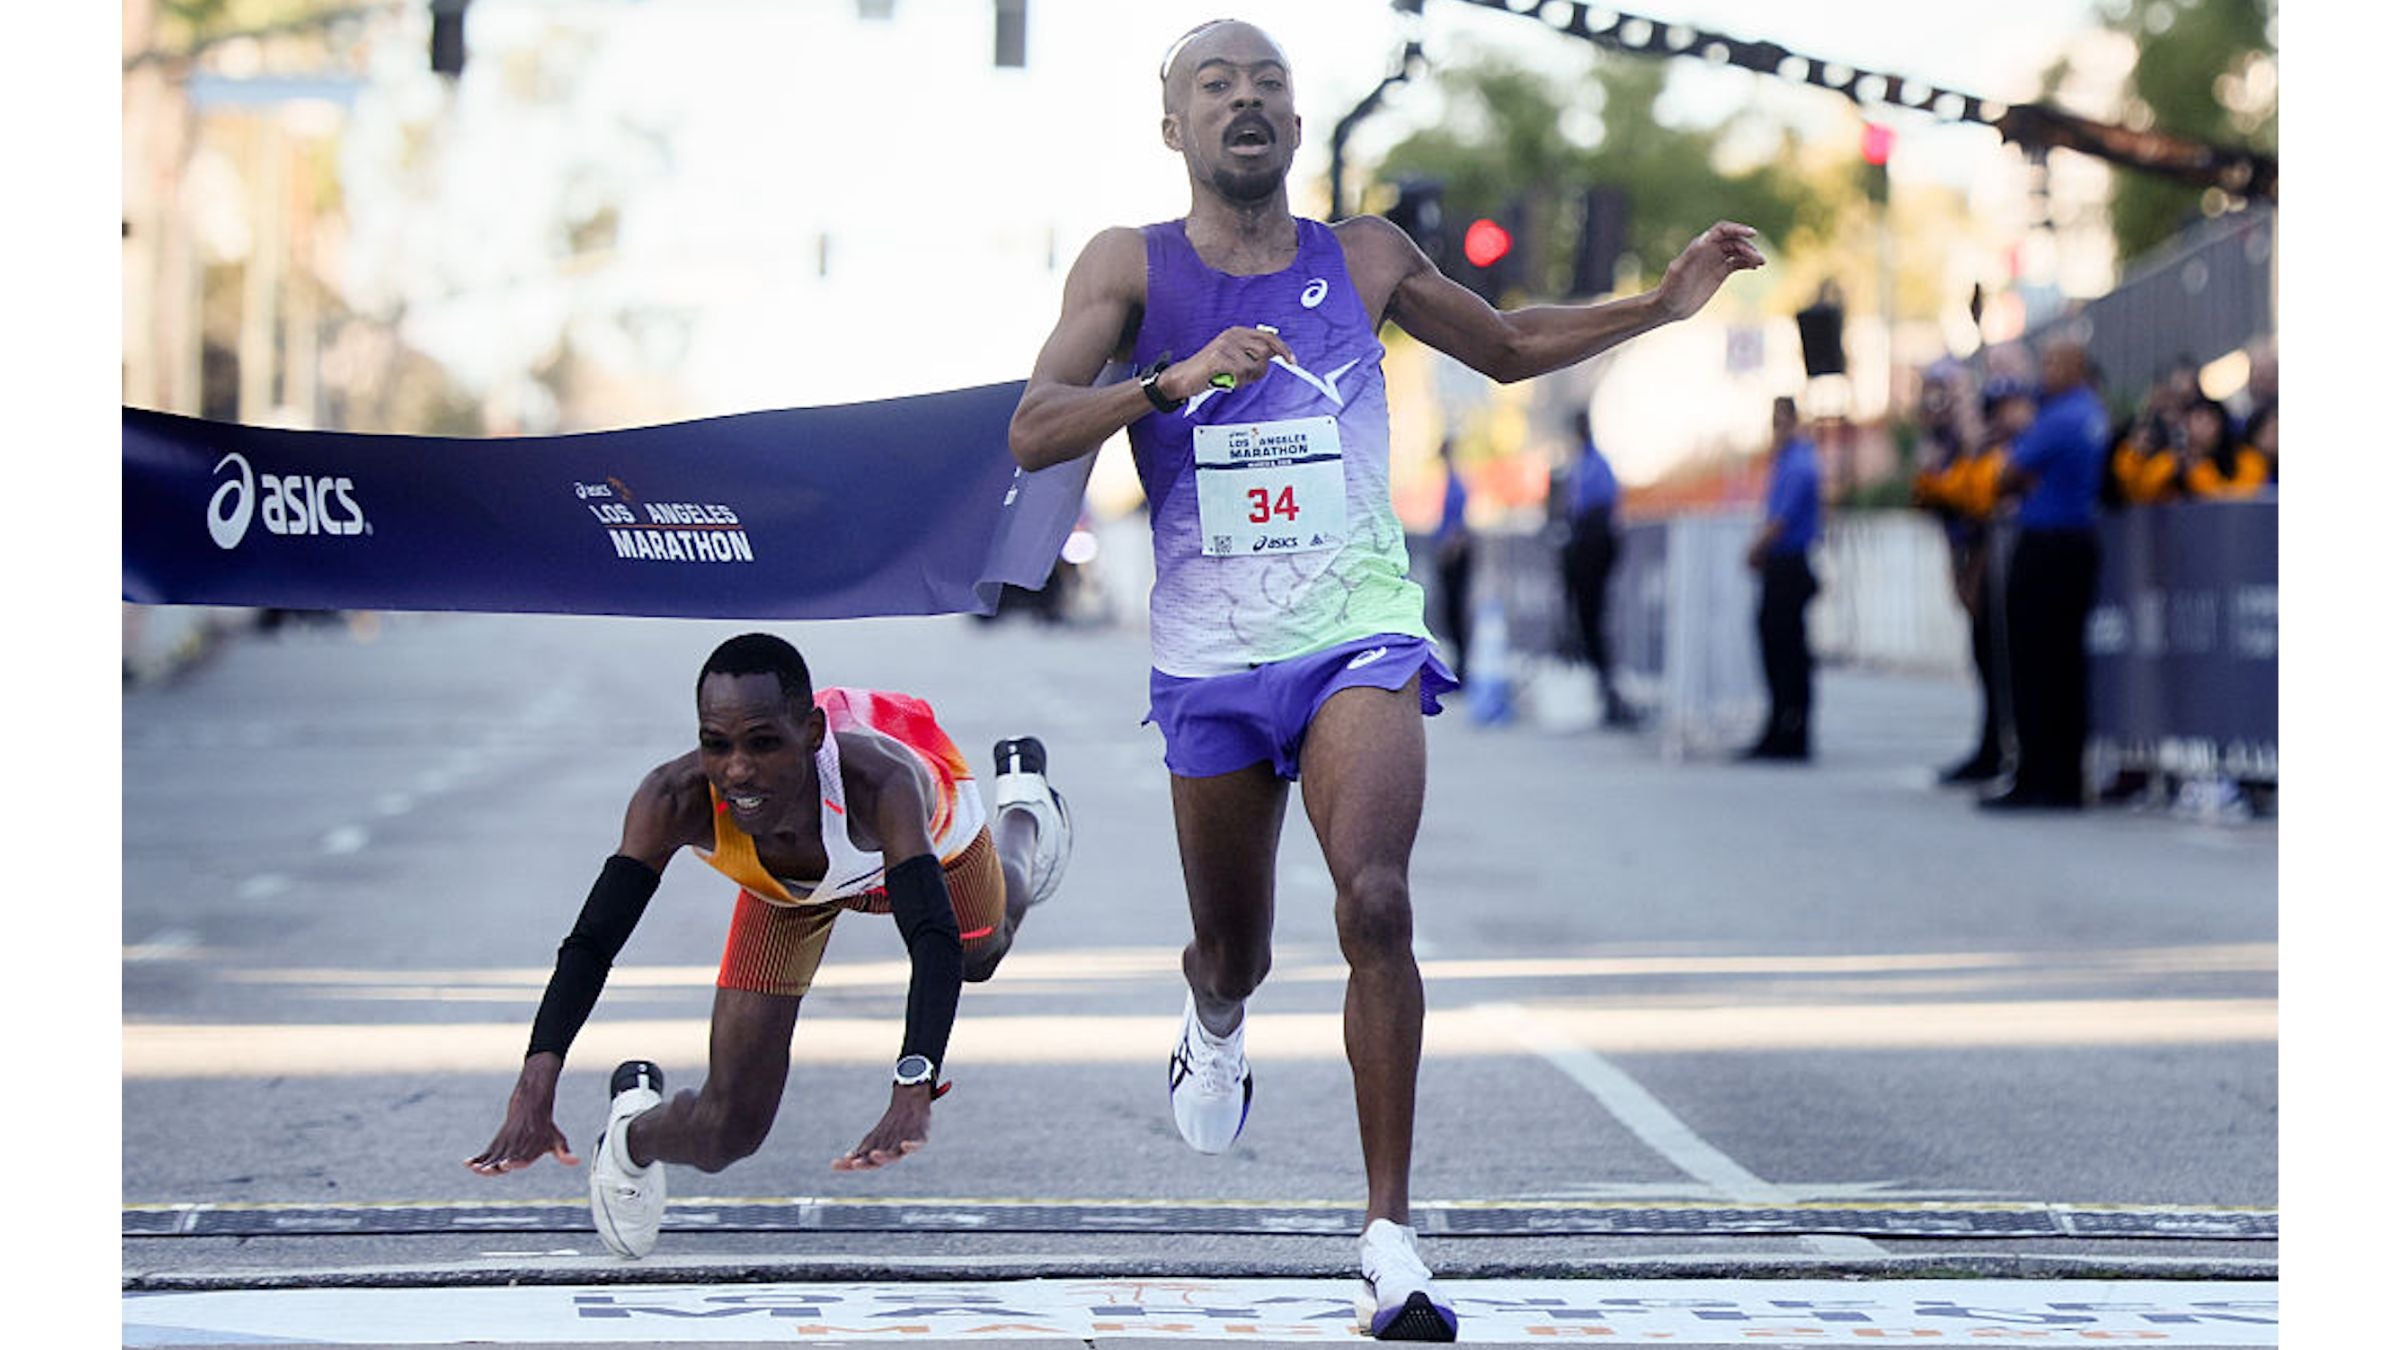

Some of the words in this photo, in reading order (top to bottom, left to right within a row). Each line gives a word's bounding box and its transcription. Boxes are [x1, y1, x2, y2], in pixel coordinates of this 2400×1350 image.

[1229, 438, 1250, 448] LOS
[1259, 434, 1307, 445] ANGELES
[1229, 444, 1309, 459] MARATHON
[588, 503, 637, 524] LOS
[643, 502, 740, 525] ANGELES
[1247, 485, 1300, 524] 34
[608, 529, 756, 563] MARATHON
